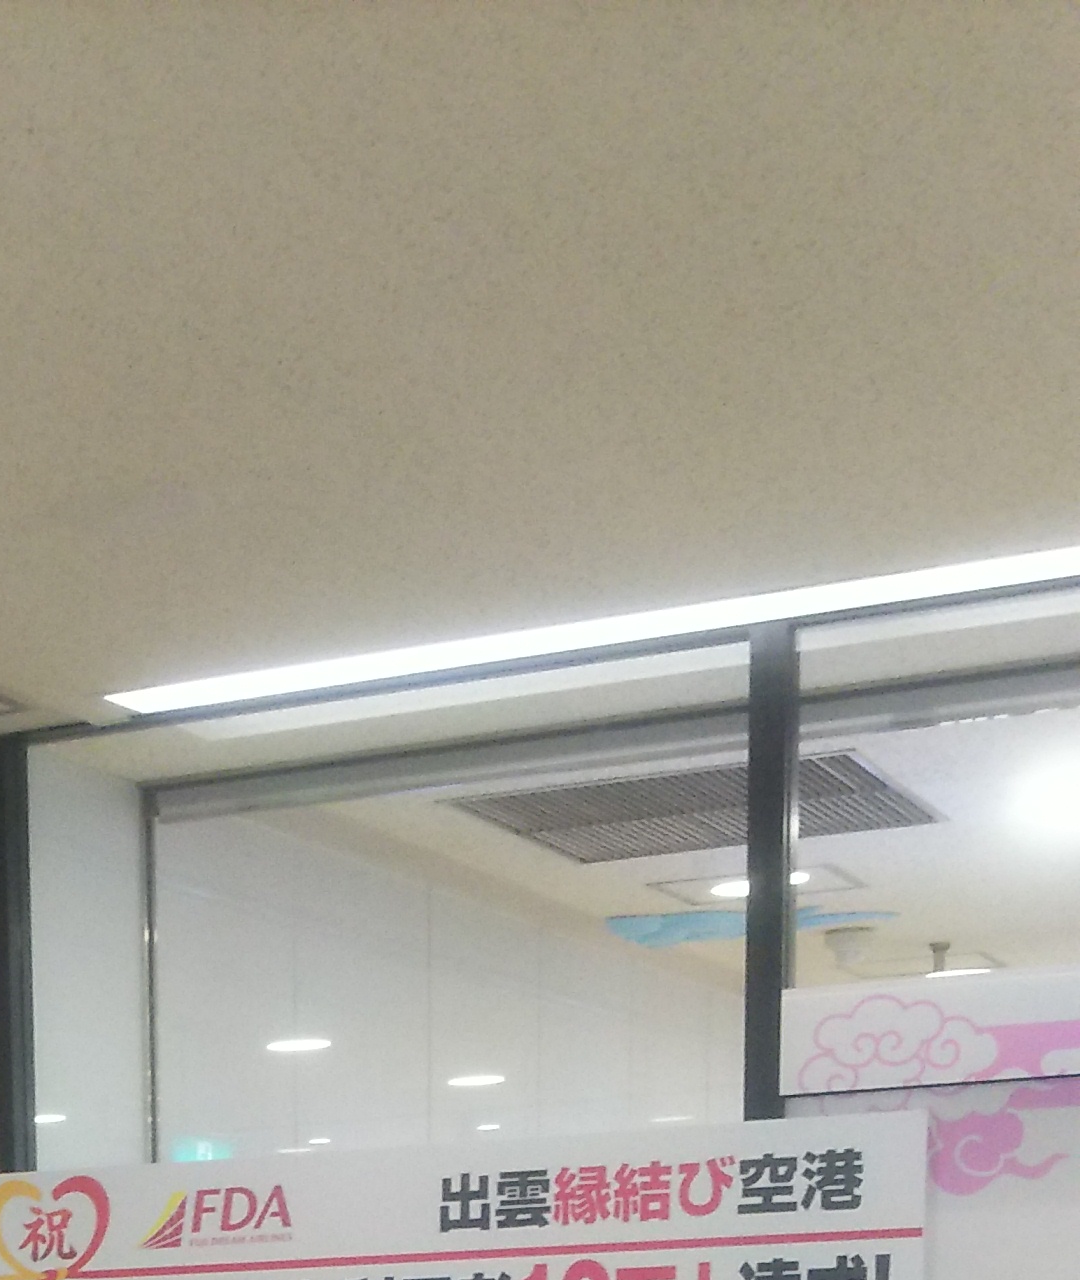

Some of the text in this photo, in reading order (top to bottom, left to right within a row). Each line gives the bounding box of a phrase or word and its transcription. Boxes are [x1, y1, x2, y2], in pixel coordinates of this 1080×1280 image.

[191, 1185, 293, 1233] FDA
[438, 1148, 864, 1233] 出雲縁結び空港
[18, 1206, 78, 1263] 祝
